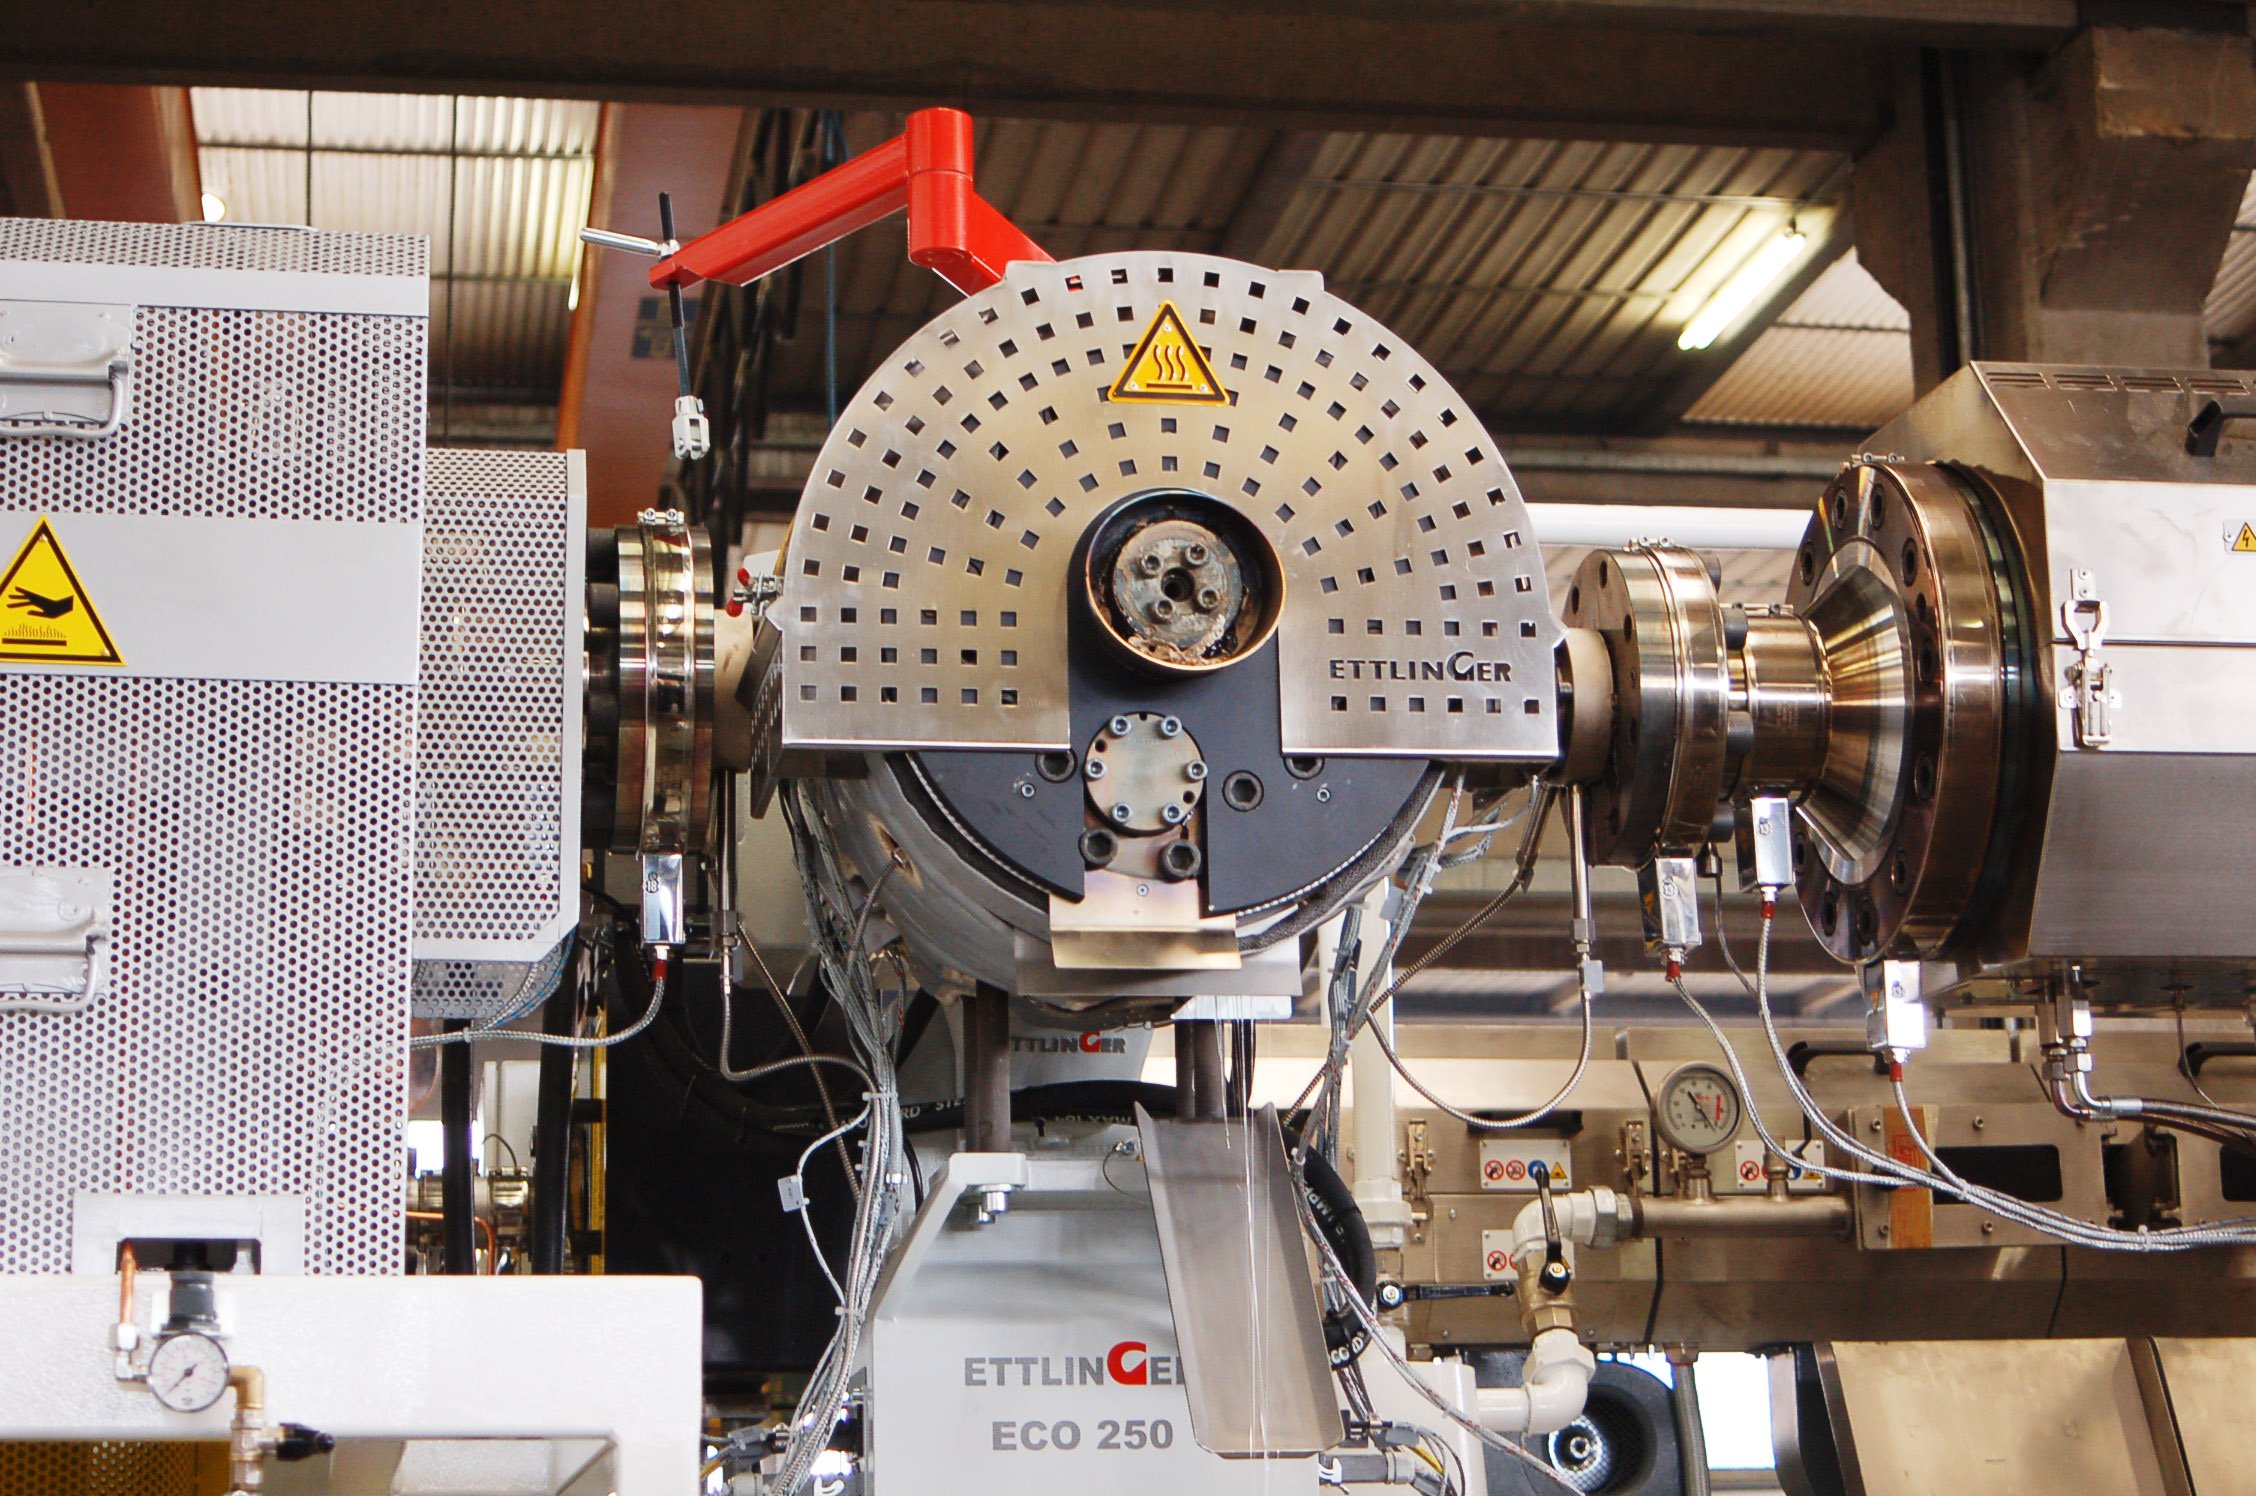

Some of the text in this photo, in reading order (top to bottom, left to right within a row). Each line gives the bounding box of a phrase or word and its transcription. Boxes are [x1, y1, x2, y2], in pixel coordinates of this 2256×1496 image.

[1329, 650, 1512, 682] ETTLINGER
[1010, 1030, 1127, 1053] TTLINGER
[992, 1419, 1174, 1451] ECO 250
